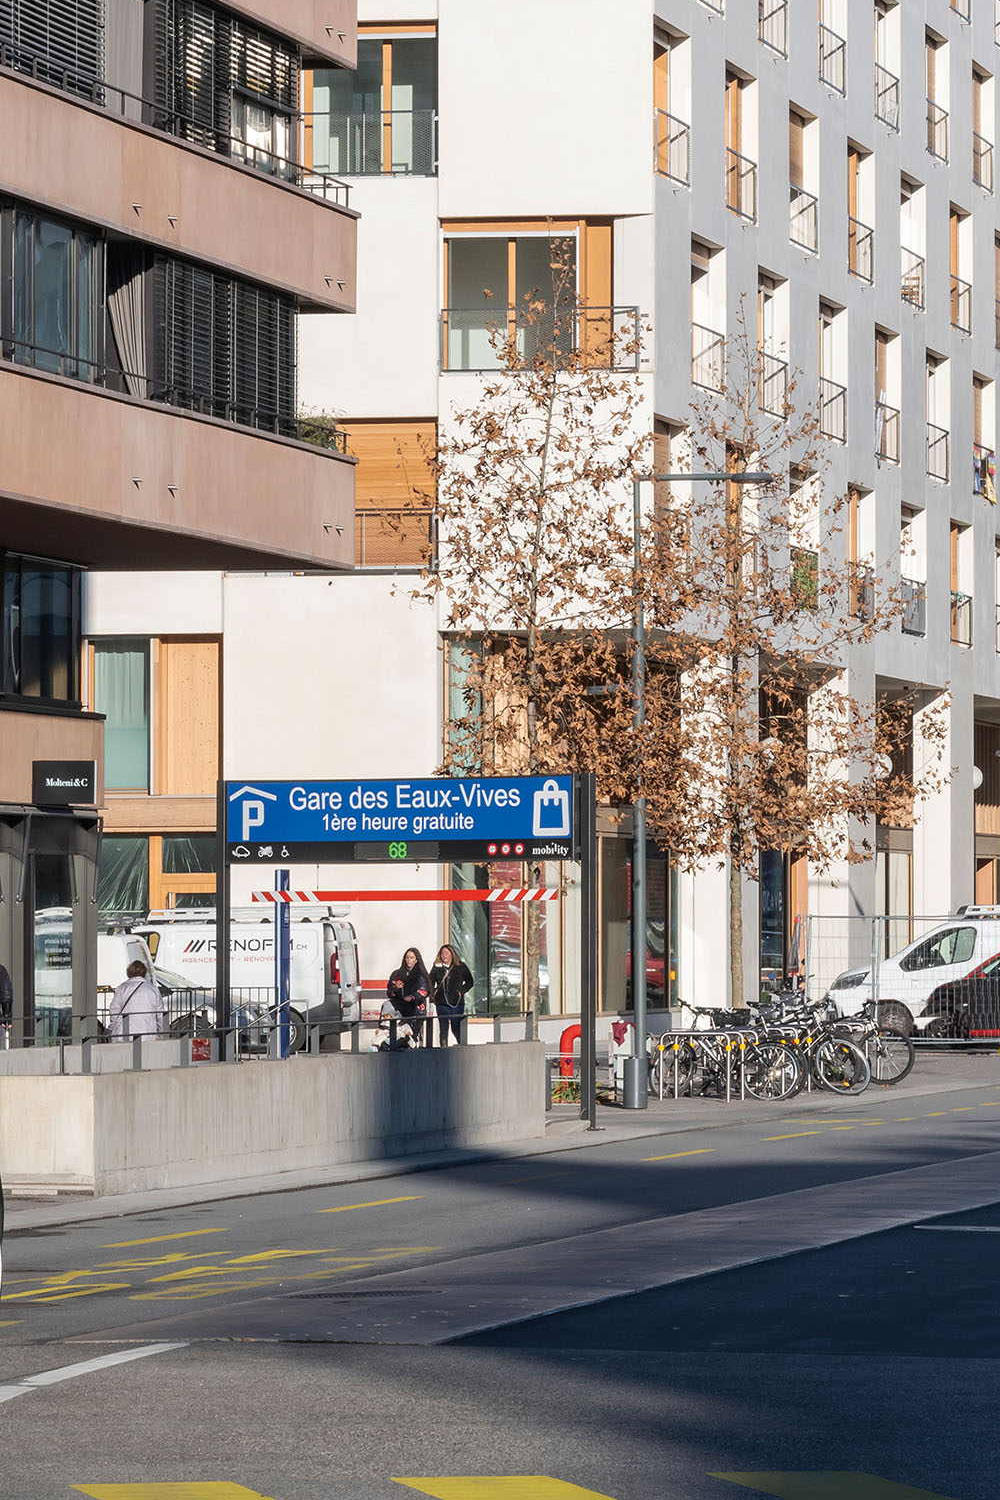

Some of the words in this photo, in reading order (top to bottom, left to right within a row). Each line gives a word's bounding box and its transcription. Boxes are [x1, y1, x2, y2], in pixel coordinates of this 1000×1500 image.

[45, 778, 88, 787] Molteni&C
[289, 787, 342, 811] Gare
[349, 786, 388, 809] des
[396, 784, 521, 808] Eaux-Vives
[242, 800, 265, 841] P
[322, 814, 357, 831] 1ère
[362, 813, 408, 830] heure
[412, 812, 474, 834] gratuite
[388, 842, 408, 859] 68
[532, 843, 569, 856] mobility
[0, 1263, 375, 1284] TAX
[0, 1280, 280, 1301] BU
